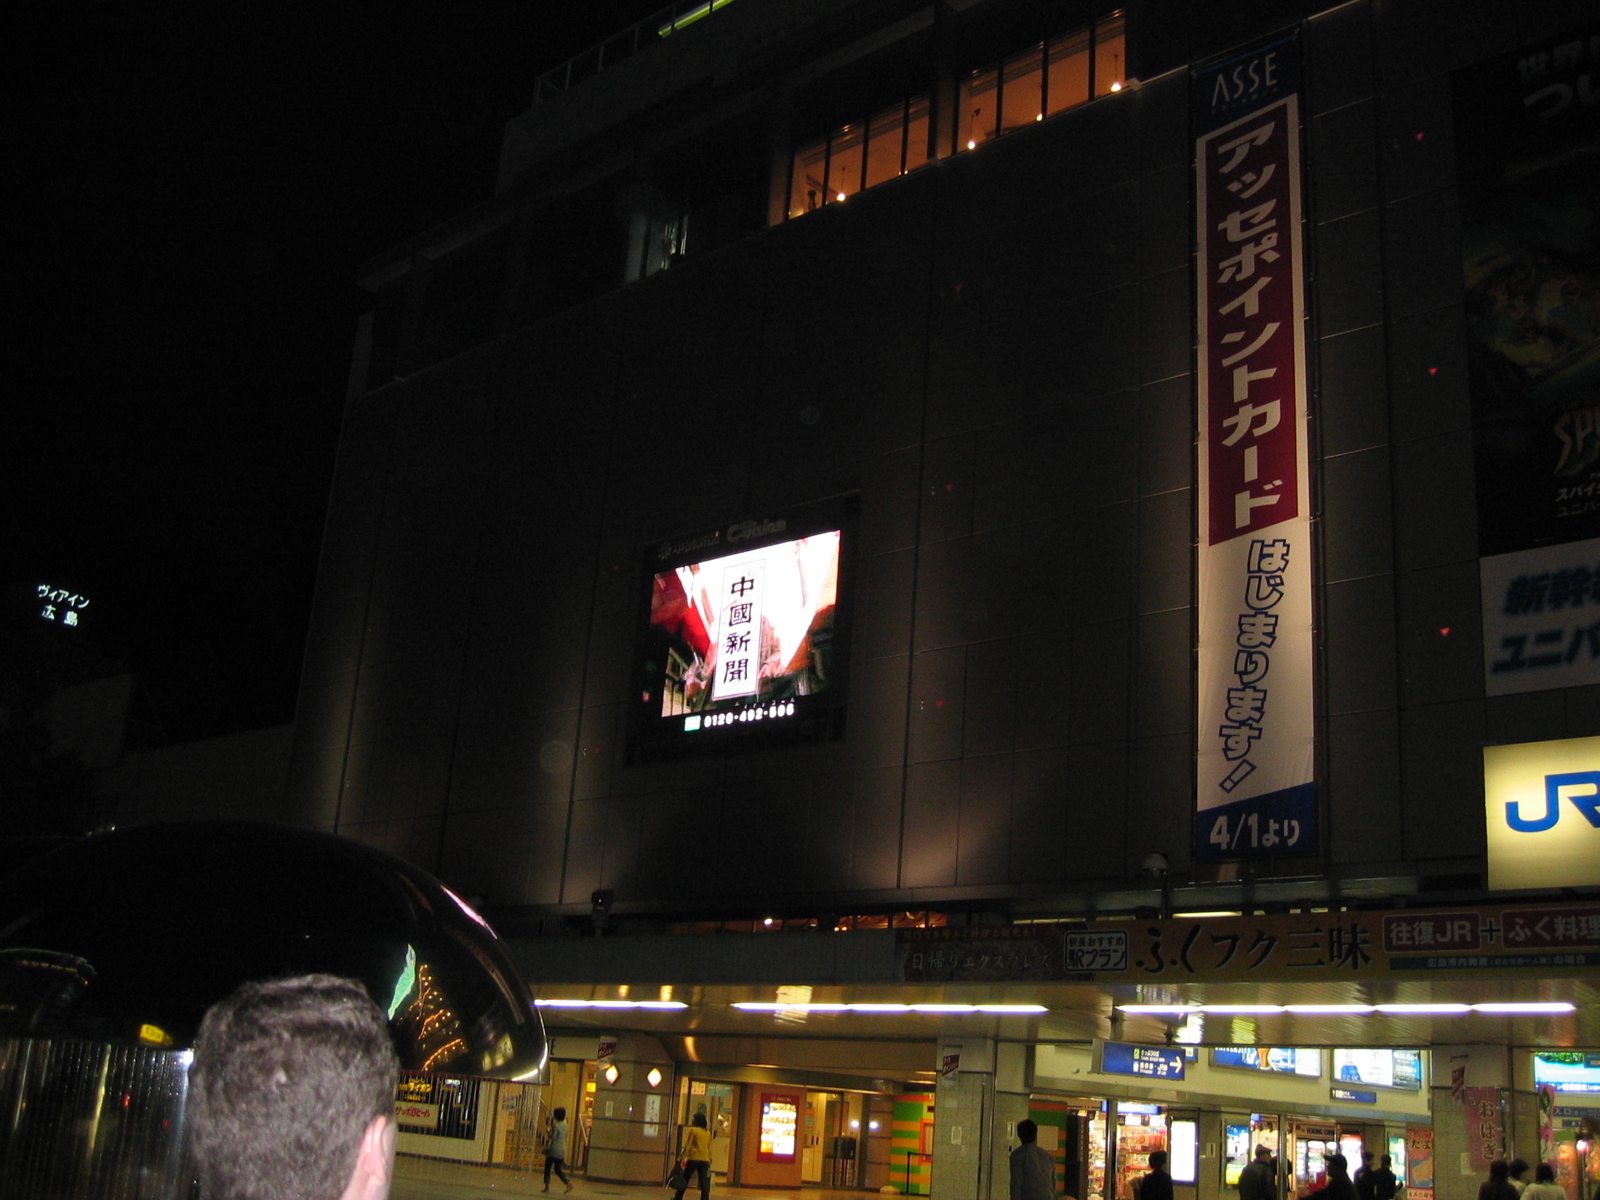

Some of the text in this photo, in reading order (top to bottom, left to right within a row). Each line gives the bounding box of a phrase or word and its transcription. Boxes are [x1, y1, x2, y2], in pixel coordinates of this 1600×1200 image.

[1211, 52, 1278, 107] ASSE
[1217, 121, 1283, 530] アッセポイントカード
[1555, 482, 1600, 502] スパイ
[38, 584, 90, 609] ヴィアイン
[42, 604, 79, 627] 広島
[1503, 563, 1600, 617] 新幹
[723, 576, 755, 684] 中國新聞
[1218, 538, 1290, 793] はじまります!
[1505, 770, 1600, 833] JR
[1209, 812, 1300, 851] 4/1より
[1389, 919, 1473, 946] 往復JR
[912, 951, 1050, 971] 日帰りエクスプレス
[1477, 1100, 1498, 1161] おはぎ
